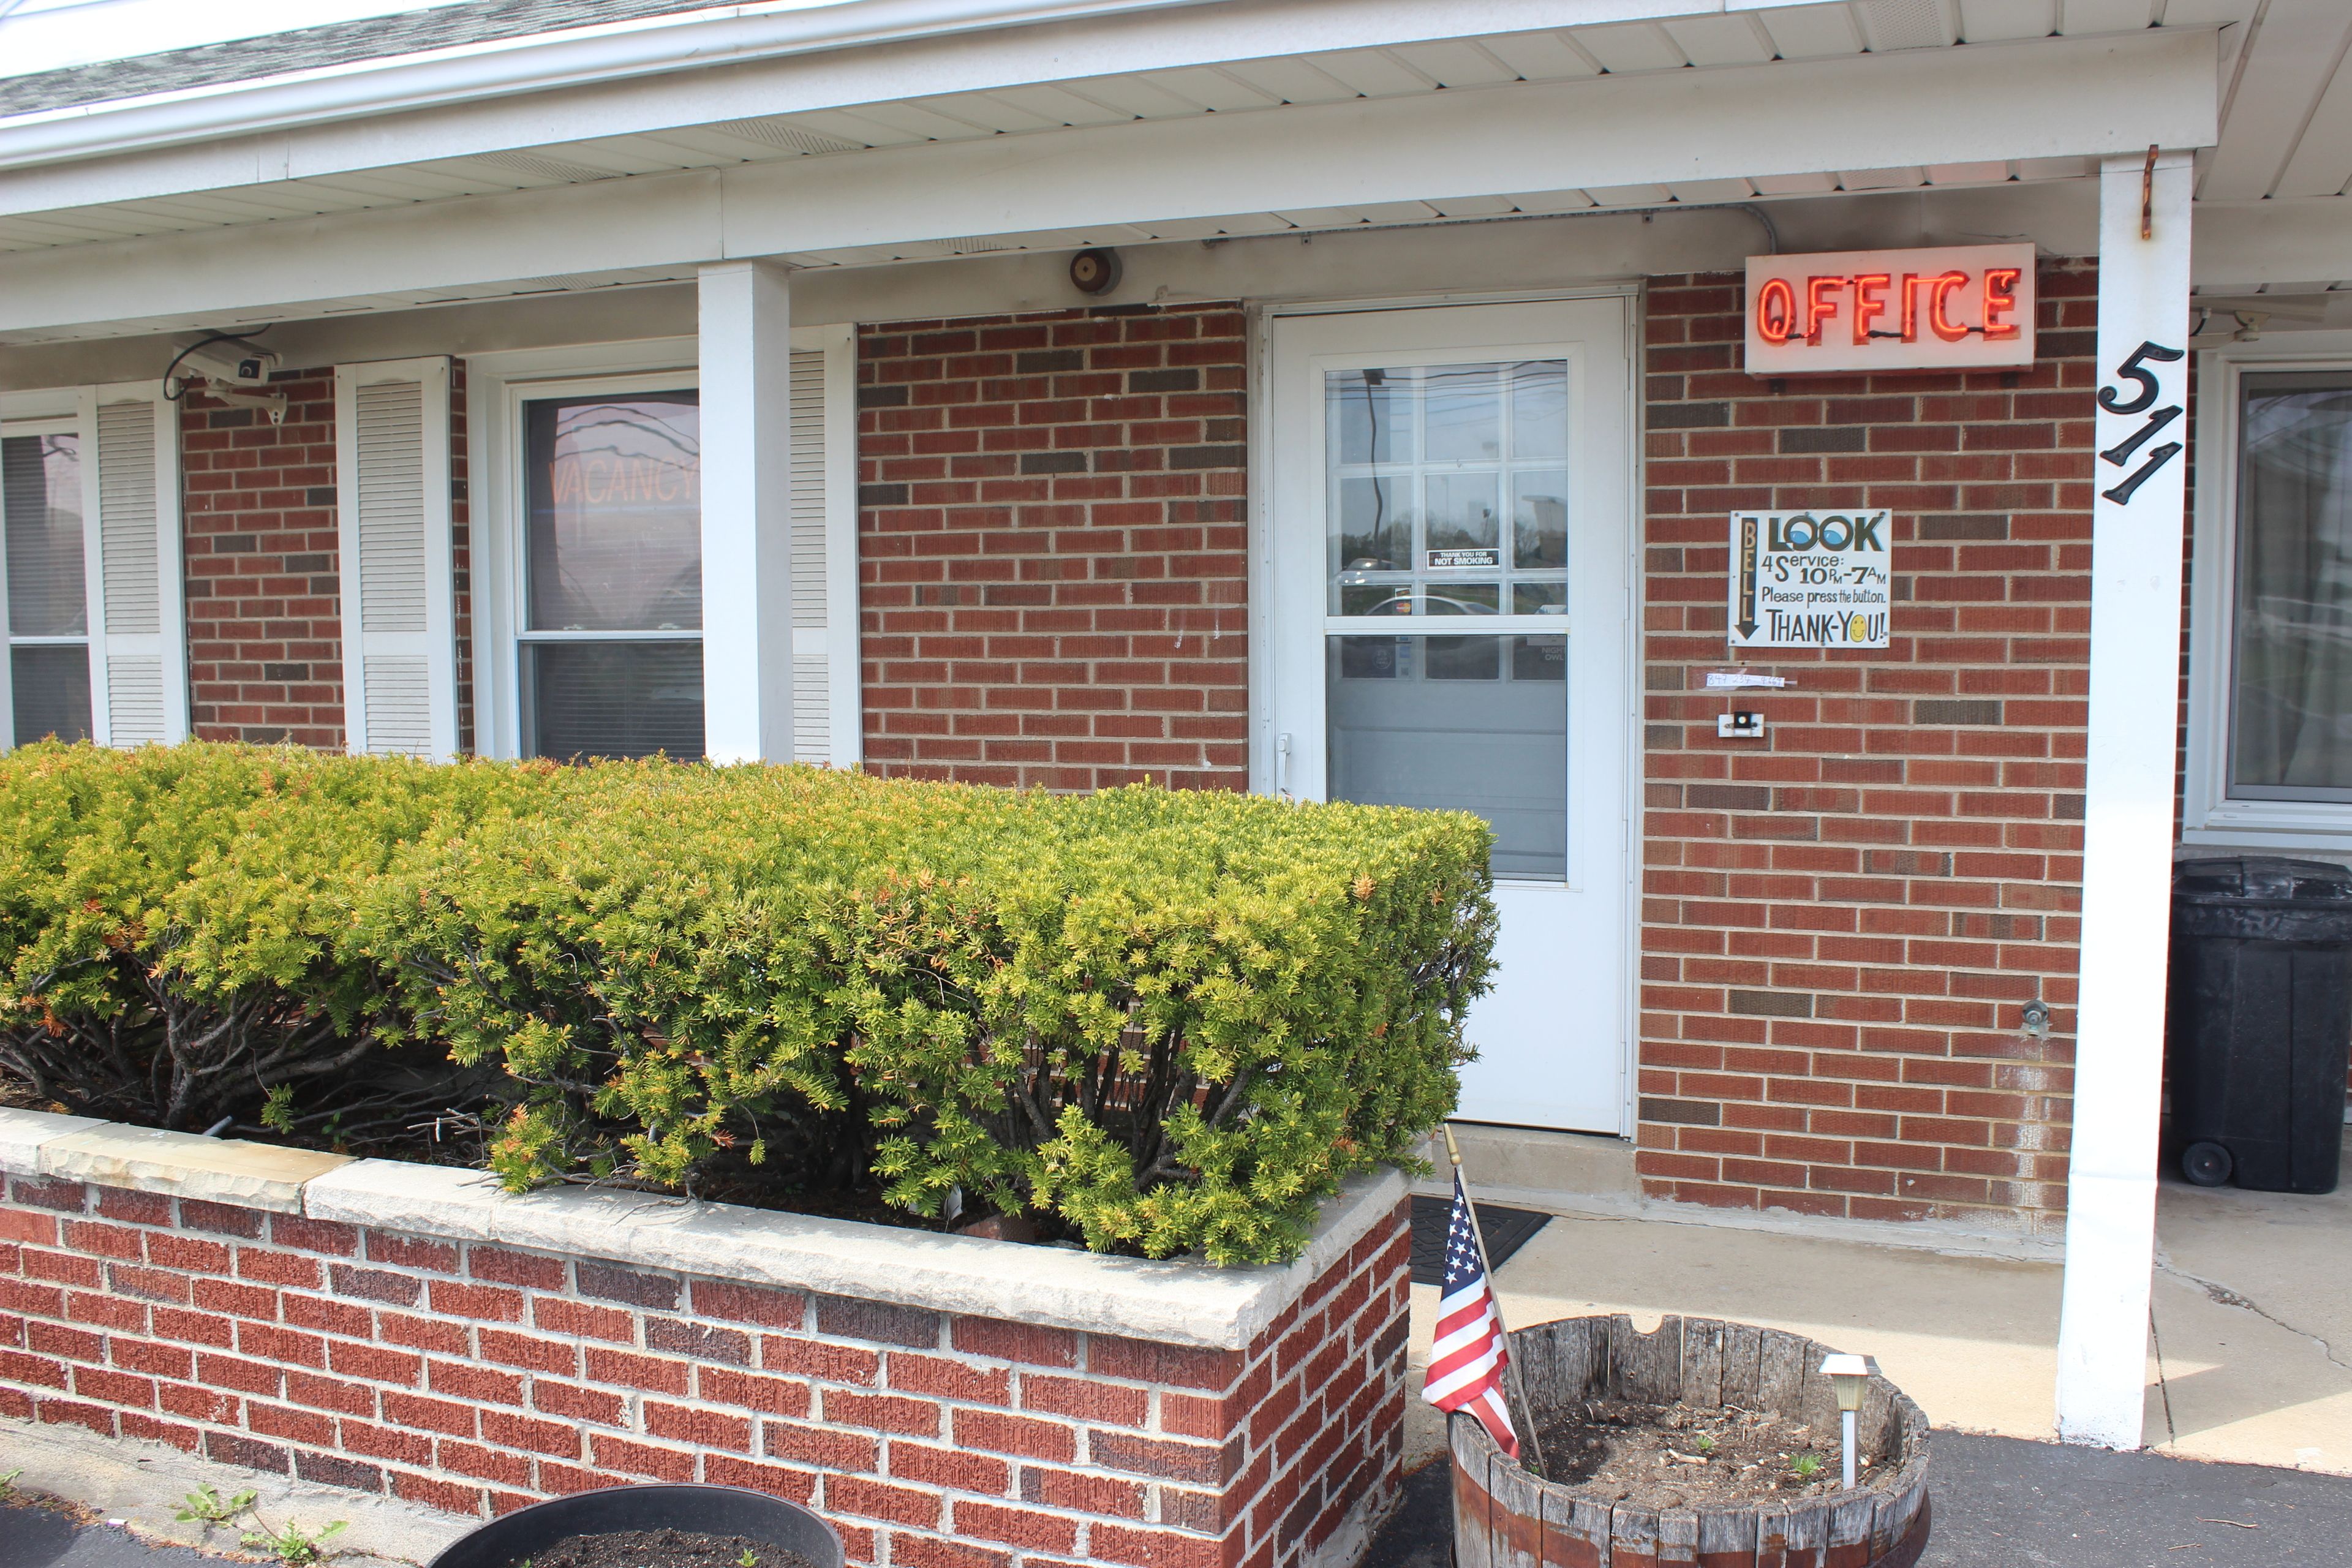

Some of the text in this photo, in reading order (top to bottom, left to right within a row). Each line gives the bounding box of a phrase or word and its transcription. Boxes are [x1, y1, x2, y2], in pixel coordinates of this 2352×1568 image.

[1757, 268, 2022, 347] OFFICE
[2097, 341, 2184, 505] 511
[549, 456, 700, 504] VACANCY
[1768, 515, 1885, 551] LOOK
[1742, 522, 1757, 621] BELL
[1761, 556, 1844, 582] 4 Service:
[1762, 586, 1886, 609] Please press the button.
[1708, 674, 1727, 685] 847
